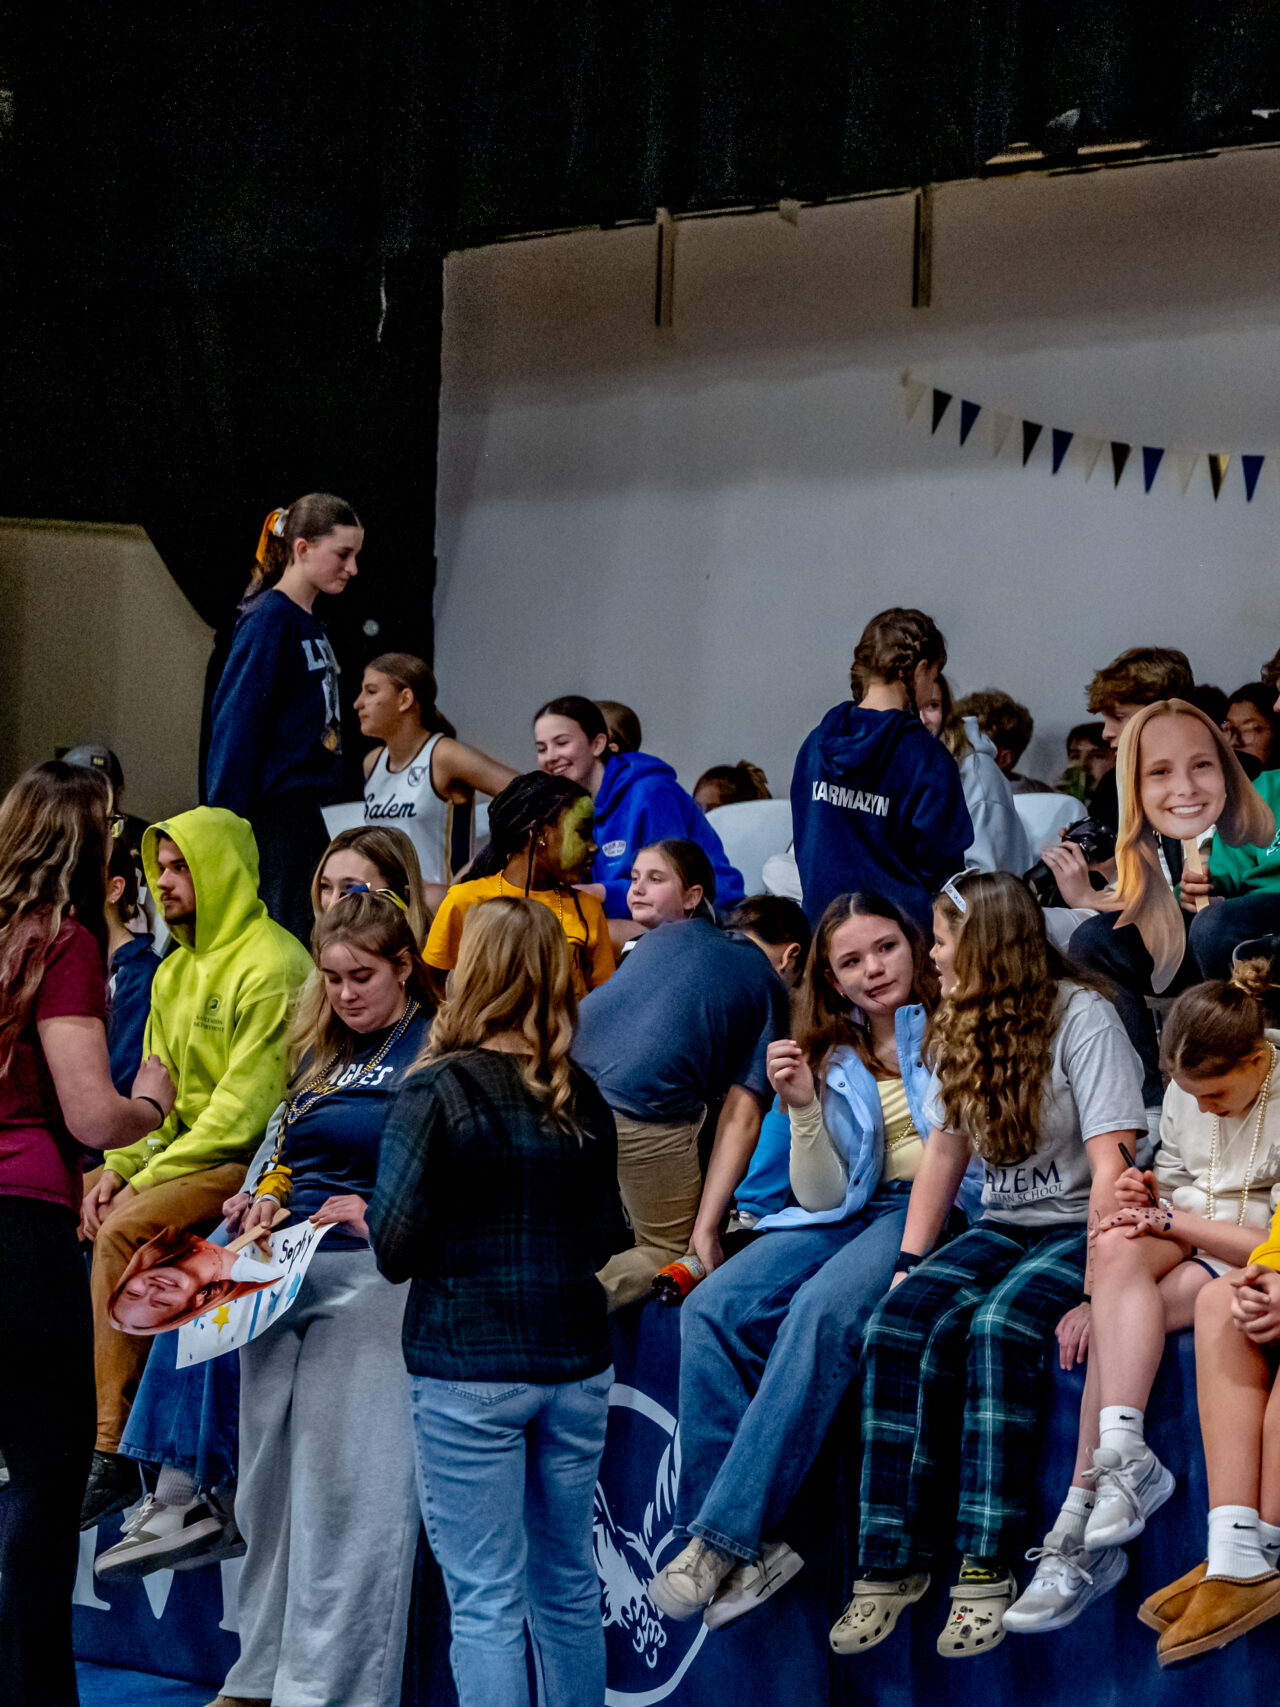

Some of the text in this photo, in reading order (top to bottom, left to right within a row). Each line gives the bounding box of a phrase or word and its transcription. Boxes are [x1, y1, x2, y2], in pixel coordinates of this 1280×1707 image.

[812, 780, 890, 817] KARMAZYN
[328, 1063, 394, 1086] GLES
[985, 1159, 1061, 1194] ALEM
[1017, 1182, 1065, 1203] SCHOOL
